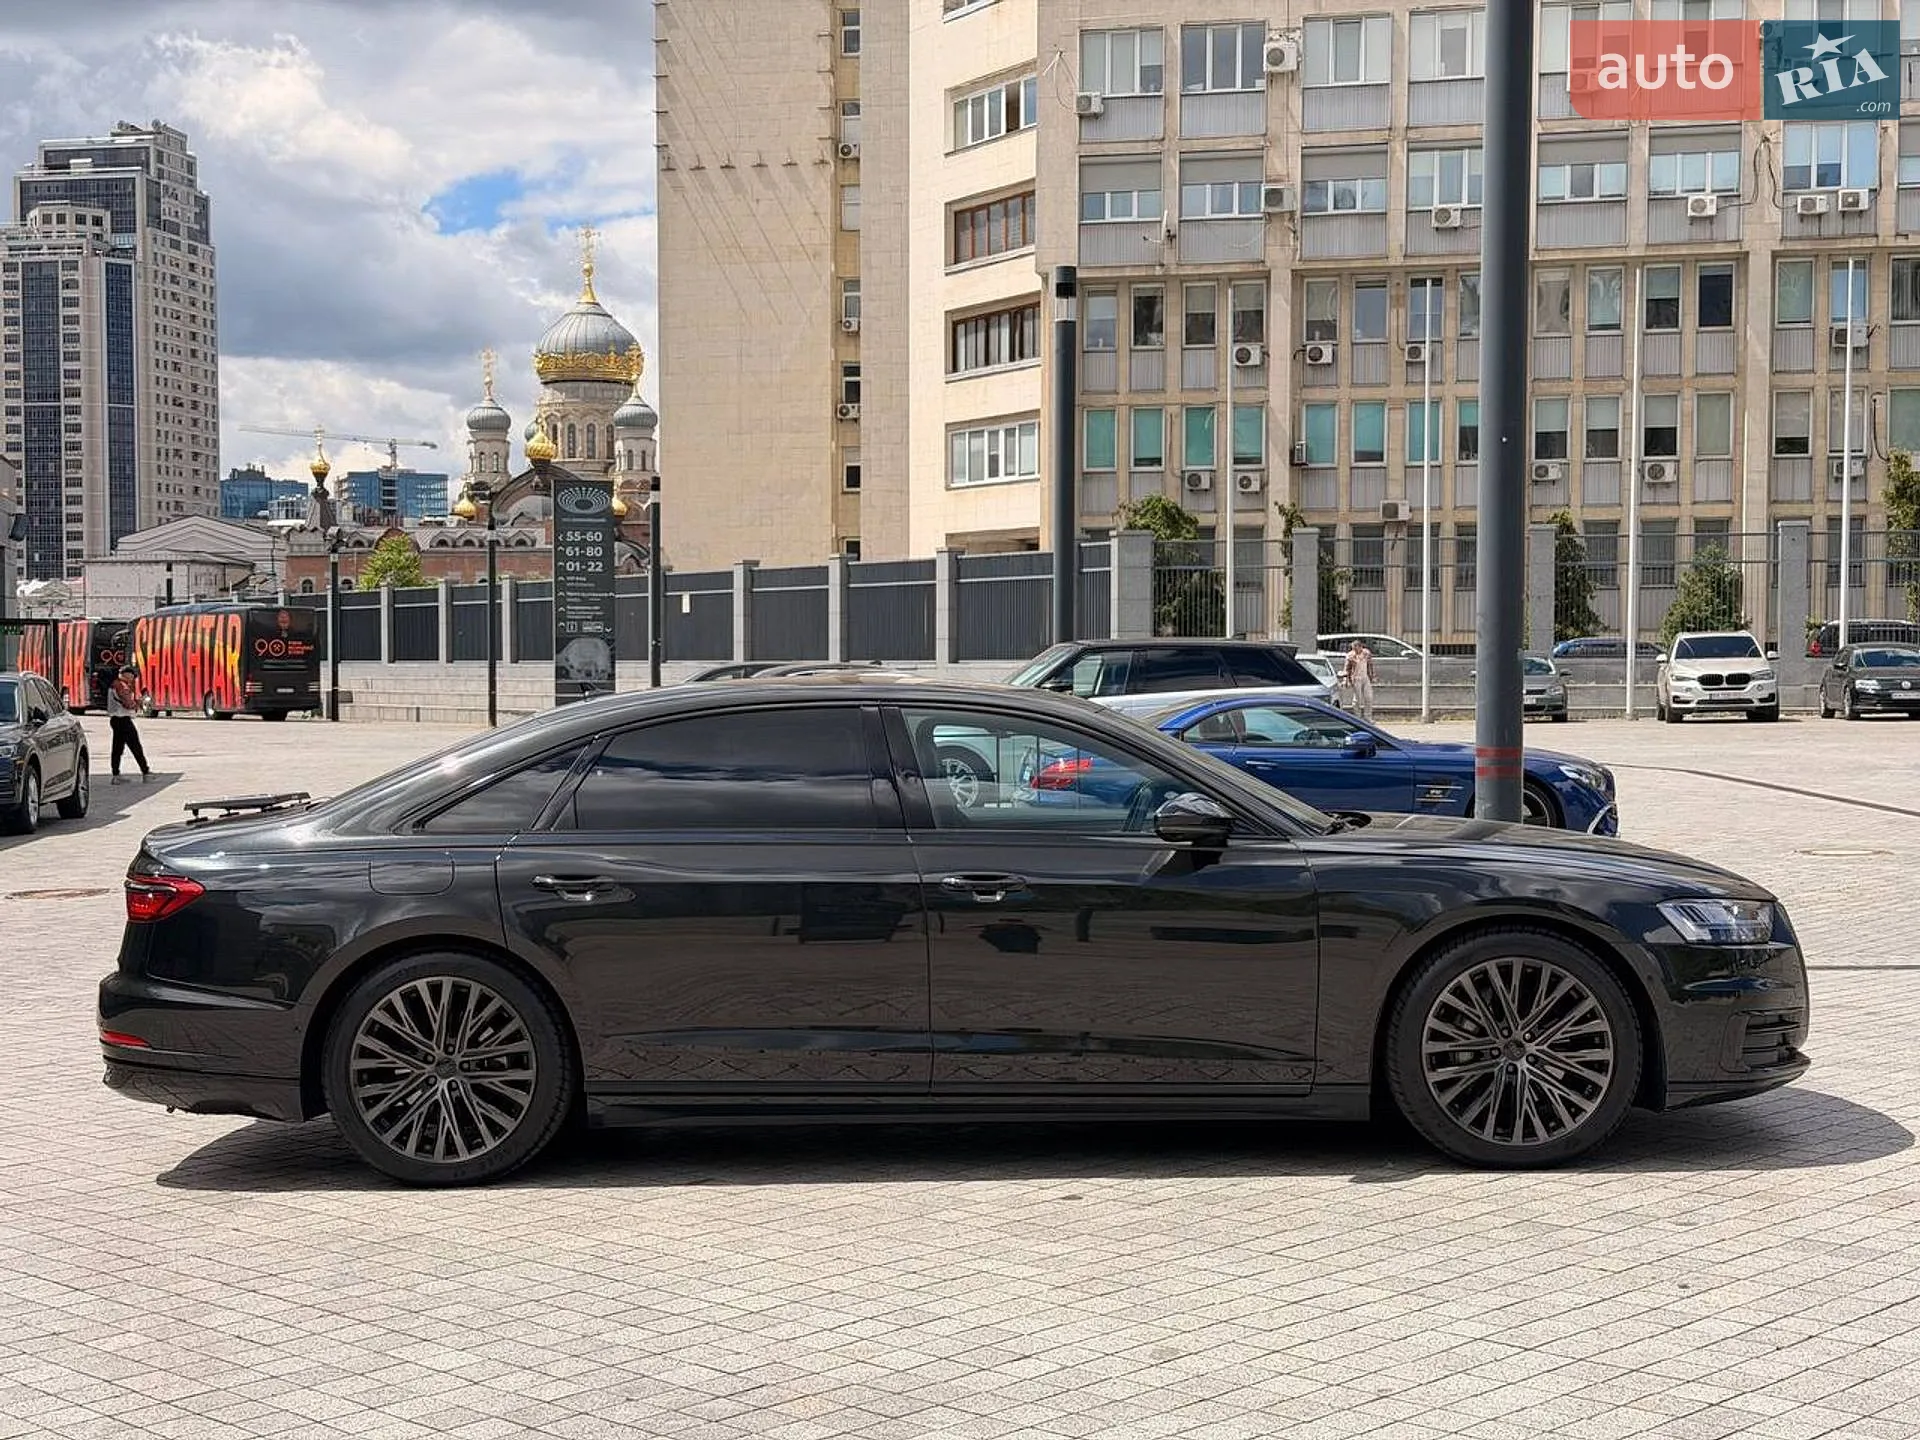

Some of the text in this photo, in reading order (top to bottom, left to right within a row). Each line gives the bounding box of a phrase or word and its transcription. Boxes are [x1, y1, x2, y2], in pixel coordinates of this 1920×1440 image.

[565, 530, 603, 542] 55-60
[565, 546, 603, 557] 61-80
[565, 561, 603, 572] 01-22
[134, 613, 243, 709] SHAKHTAR
